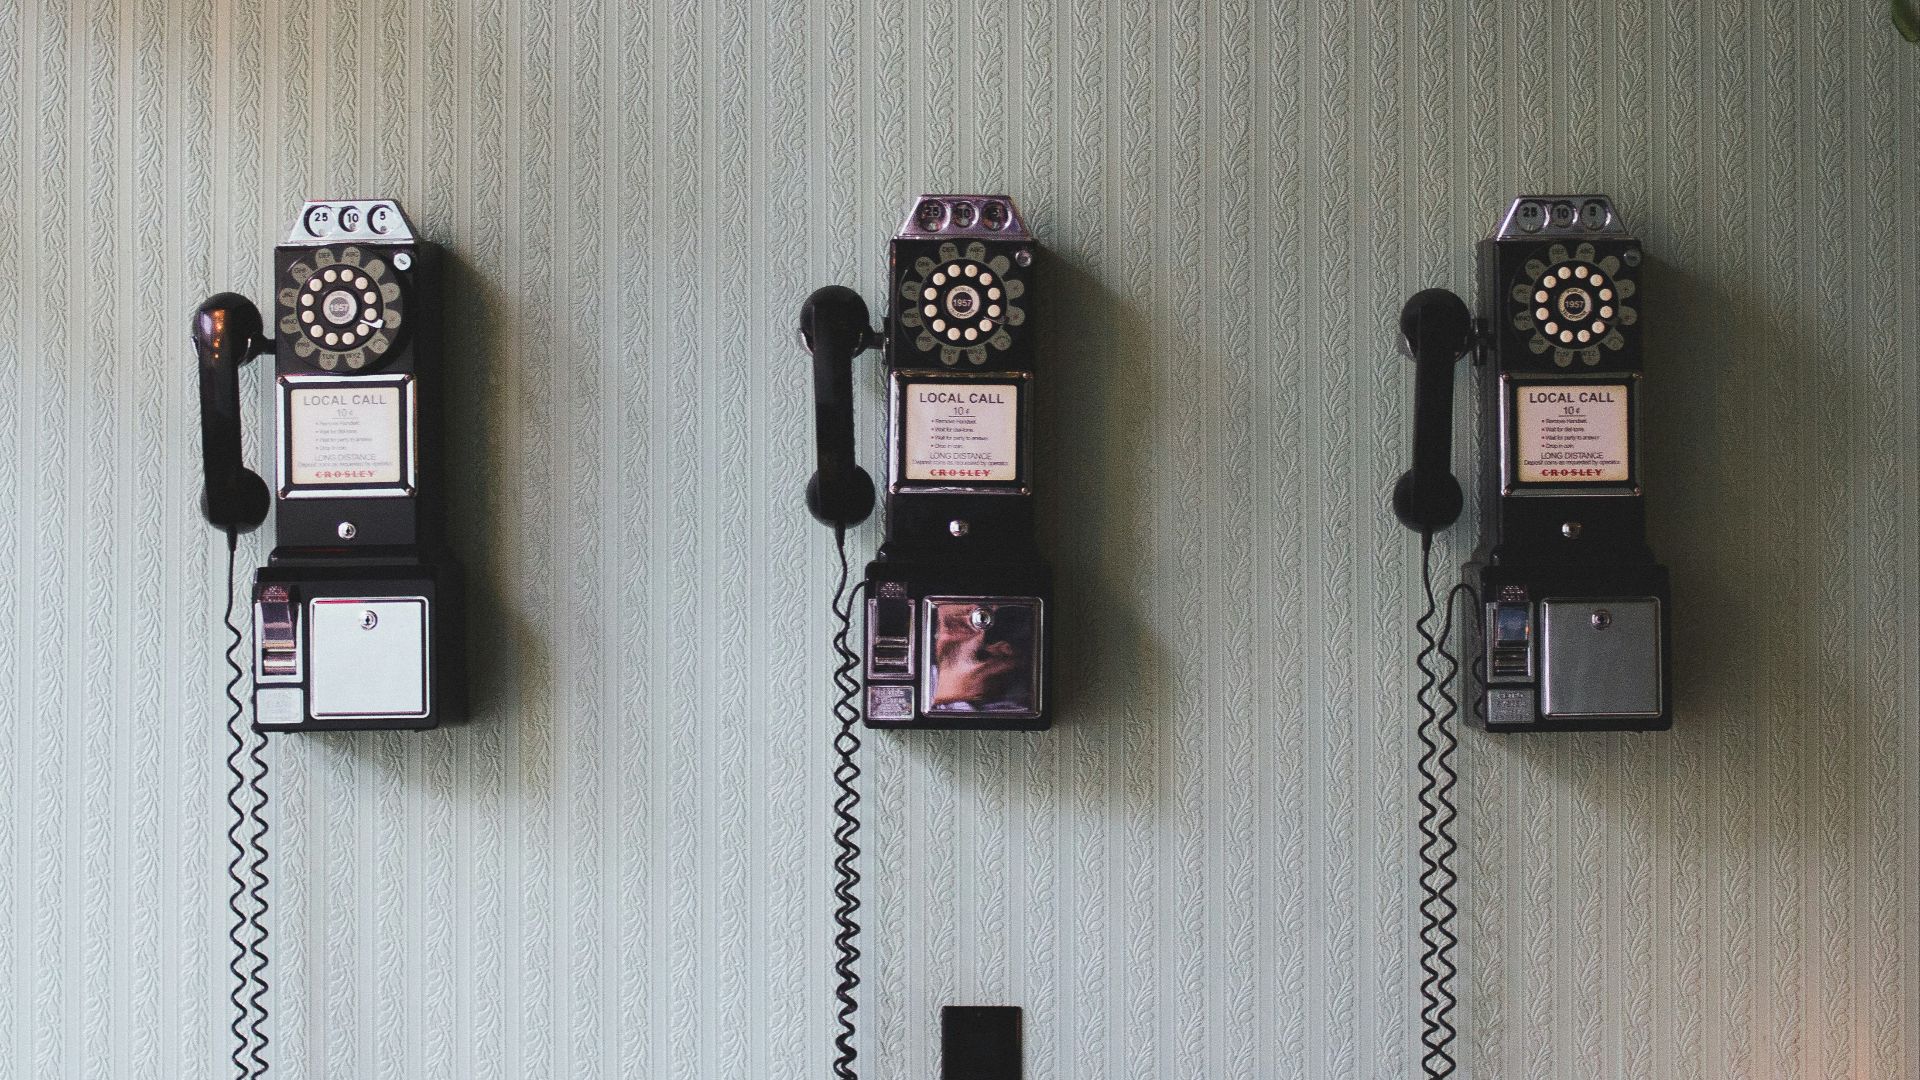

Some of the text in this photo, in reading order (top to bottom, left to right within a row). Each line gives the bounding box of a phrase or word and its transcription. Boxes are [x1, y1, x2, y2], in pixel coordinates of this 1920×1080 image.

[1523, 206, 1538, 217] 25
[1557, 208, 1569, 219] 10
[314, 211, 386, 223] 25 10 5
[953, 299, 972, 307] 1957
[1565, 300, 1584, 308] 1957
[303, 394, 387, 406] LOCAL CALL
[920, 392, 1005, 404] LOCAL CALL
[1529, 392, 1614, 403] LOCAL CALL
[930, 452, 992, 460] LONG DISTANCE
[1541, 452, 1604, 460] LONG DISTANCE
[315, 470, 375, 478] CROSLEY
[930, 469, 991, 477] CROSLEY
[1541, 469, 1602, 477] CROSLEY
